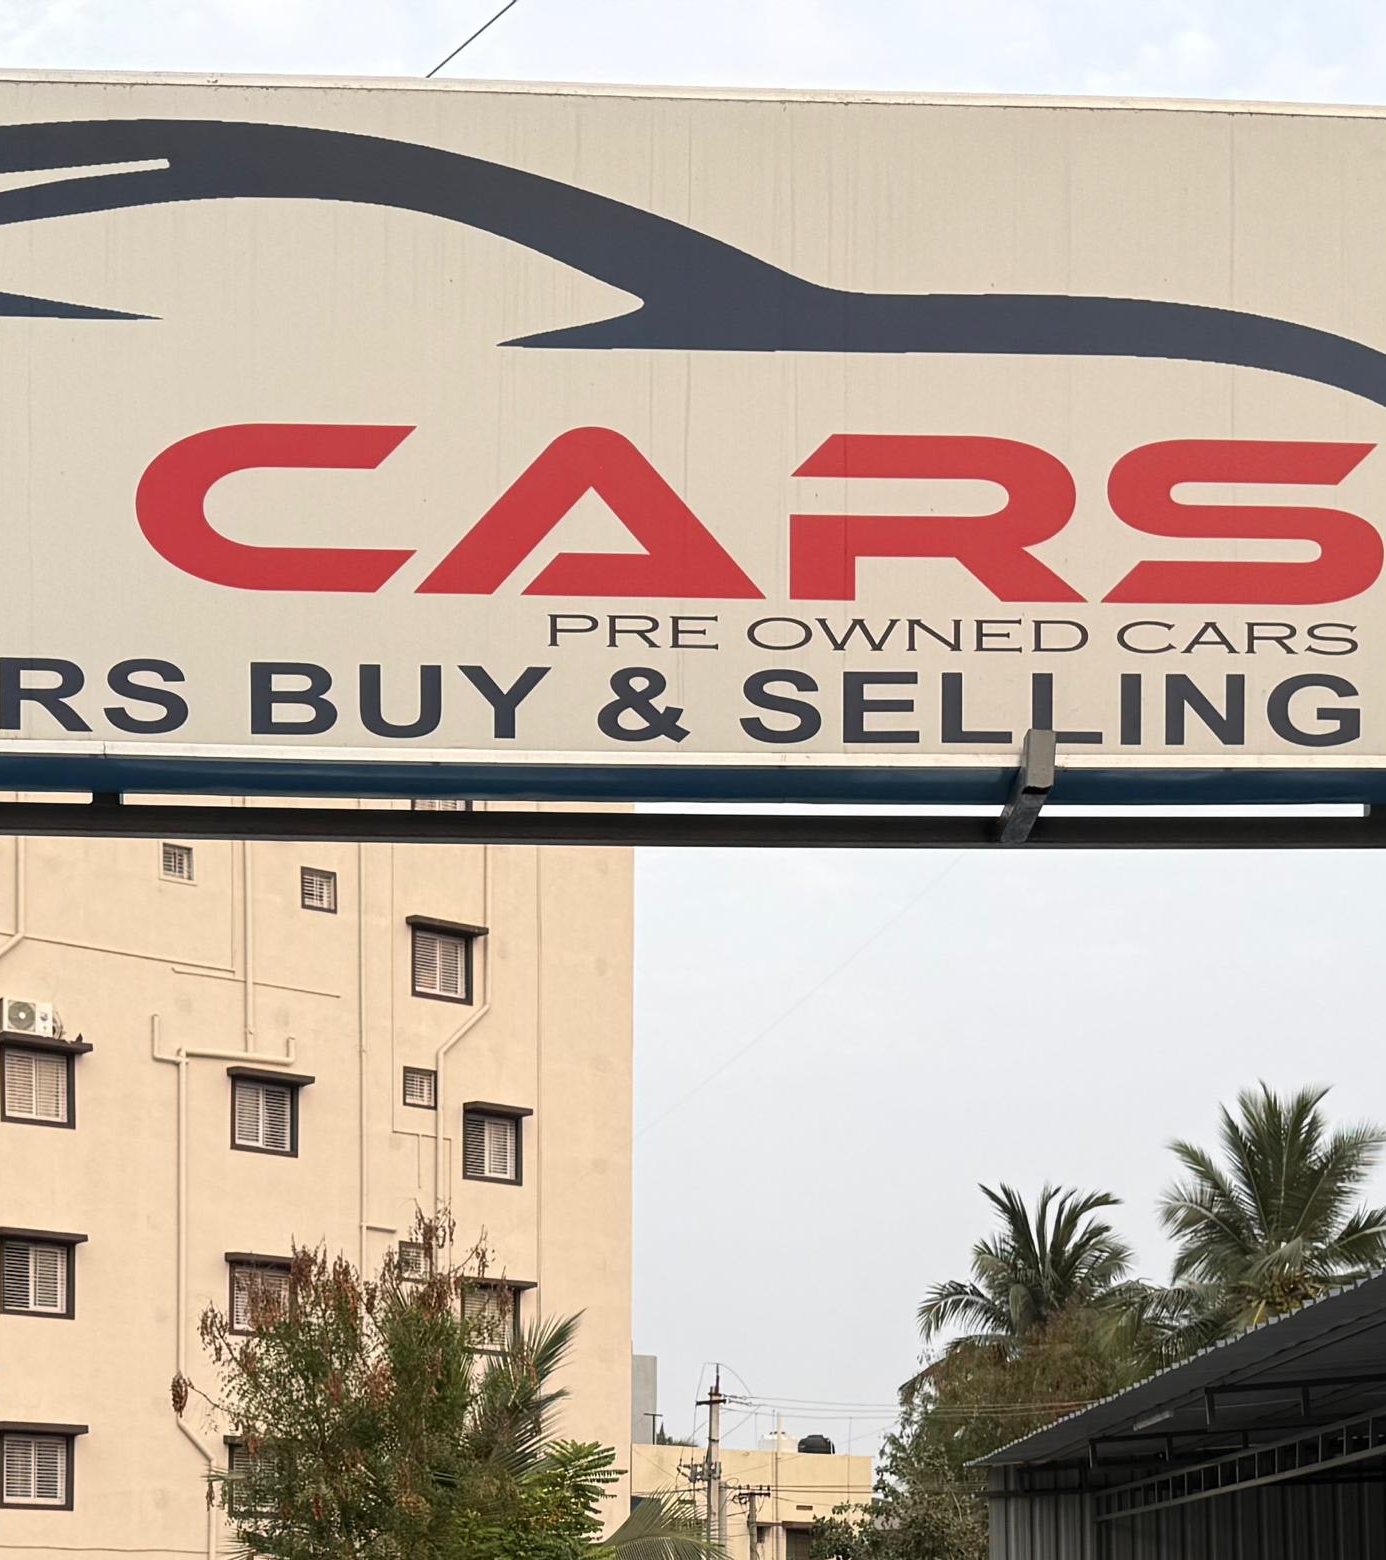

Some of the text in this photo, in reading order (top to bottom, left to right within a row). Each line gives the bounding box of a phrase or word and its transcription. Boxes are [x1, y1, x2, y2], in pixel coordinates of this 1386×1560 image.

[135, 423, 1385, 606] CARS
[547, 613, 1359, 656] PRE OWNED CARS
[250, 661, 552, 739] BUY
[597, 666, 691, 743] &
[739, 669, 1361, 747] SELLING
